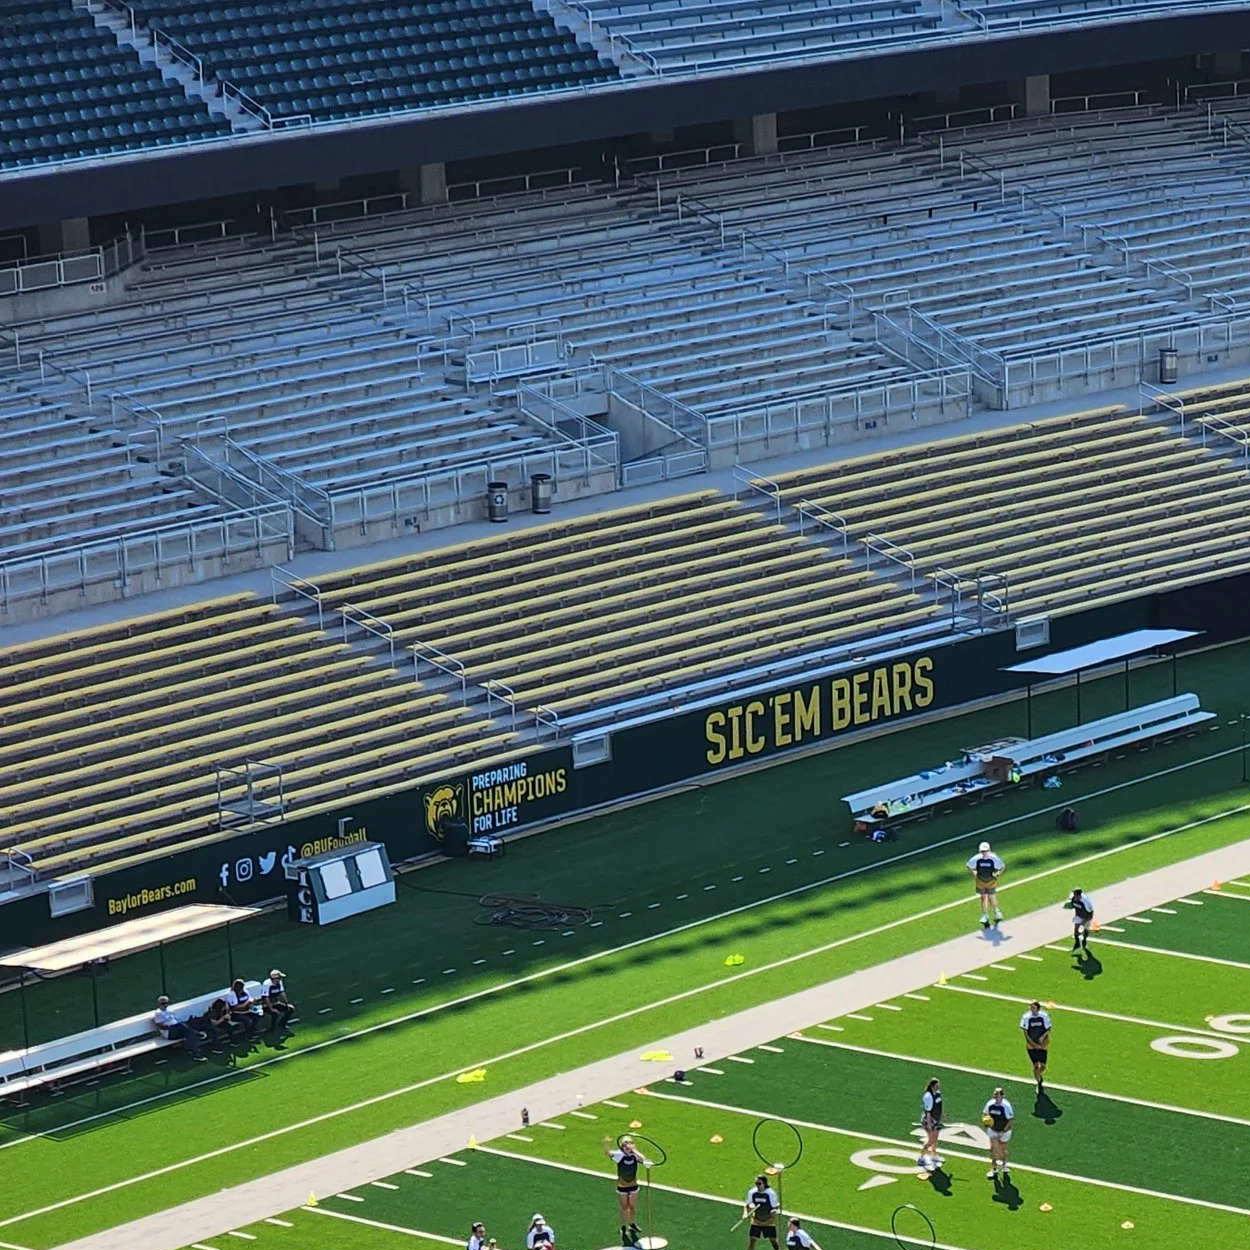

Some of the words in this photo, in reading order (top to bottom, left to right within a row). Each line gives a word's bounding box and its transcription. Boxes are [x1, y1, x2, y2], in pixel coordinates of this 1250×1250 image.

[832, 656, 934, 731] BEARS
[472, 762, 528, 791] PREPARING
[473, 768, 567, 816] CHAMPIONS
[473, 814, 493, 834] FOR
[495, 806, 518, 827] LIFE
[108, 877, 196, 916] BaylorBears.com
[297, 869, 314, 924] ICE
